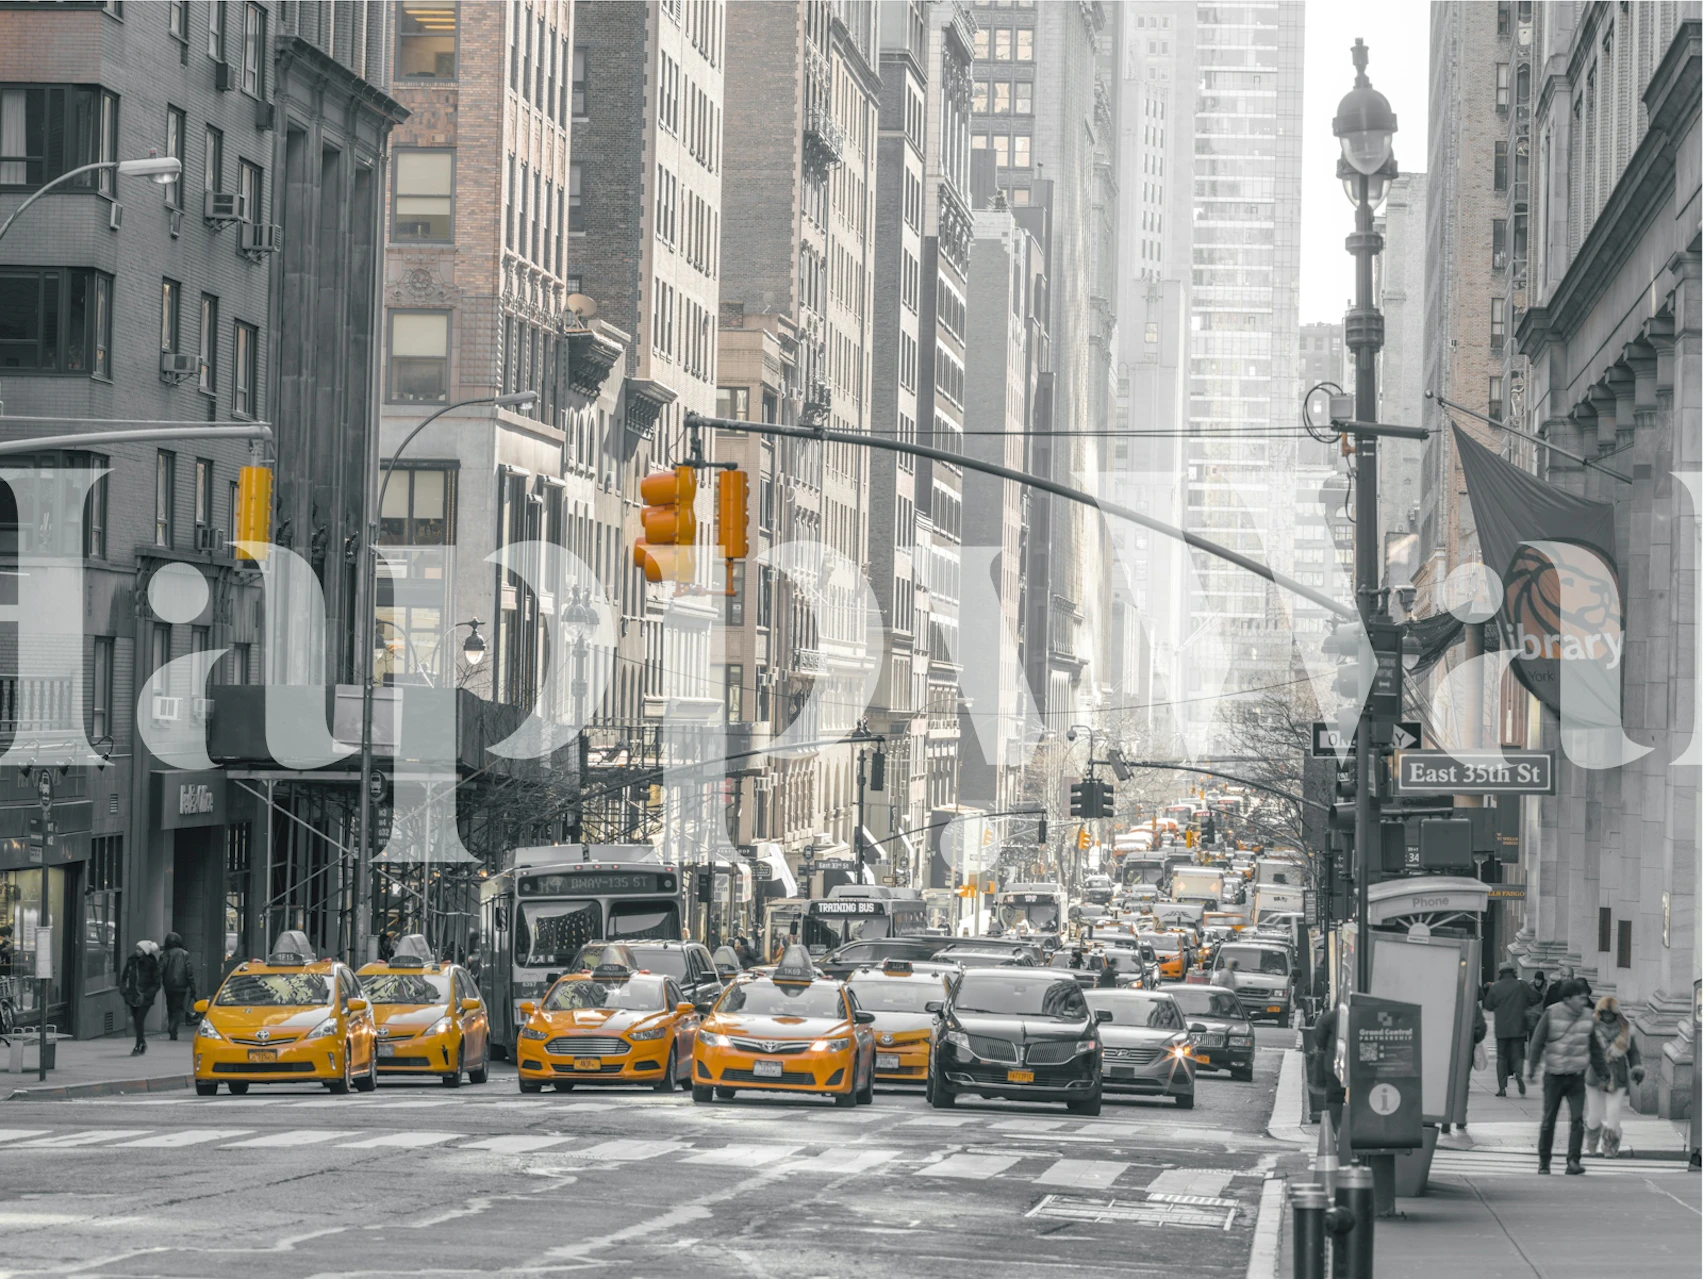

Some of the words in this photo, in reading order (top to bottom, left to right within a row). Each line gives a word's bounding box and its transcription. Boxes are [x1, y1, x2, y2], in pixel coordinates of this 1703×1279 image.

[1528, 670, 1555, 682] York
[1409, 762, 1457, 783] East
[1463, 763, 1511, 783] 35th
[1517, 763, 1540, 783] St
[633, 876, 648, 888] ST
[818, 903, 857, 913] TRAINING
[858, 903, 875, 912] BUS
[1412, 895, 1450, 909] Phone
[1359, 1028, 1384, 1036] Grand
[1385, 1028, 1413, 1036] Central
